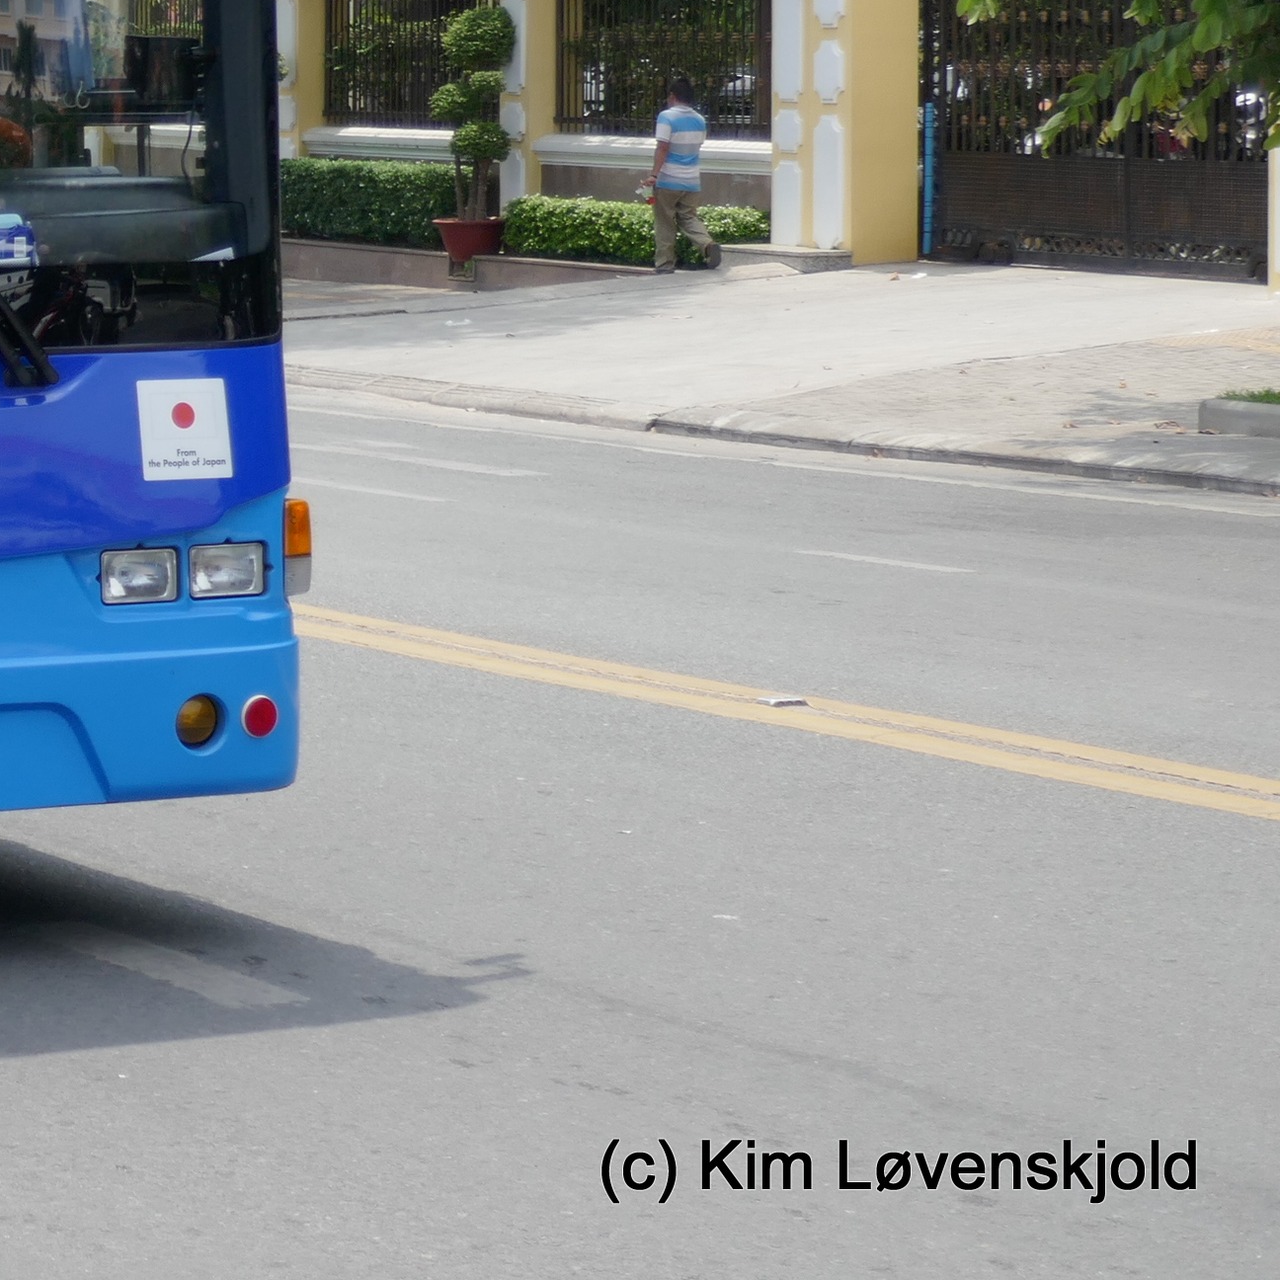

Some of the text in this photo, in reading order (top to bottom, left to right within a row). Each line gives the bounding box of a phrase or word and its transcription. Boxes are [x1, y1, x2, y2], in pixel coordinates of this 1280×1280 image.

[176, 448, 197, 456] From
[148, 457, 226, 468] the People of Japan
